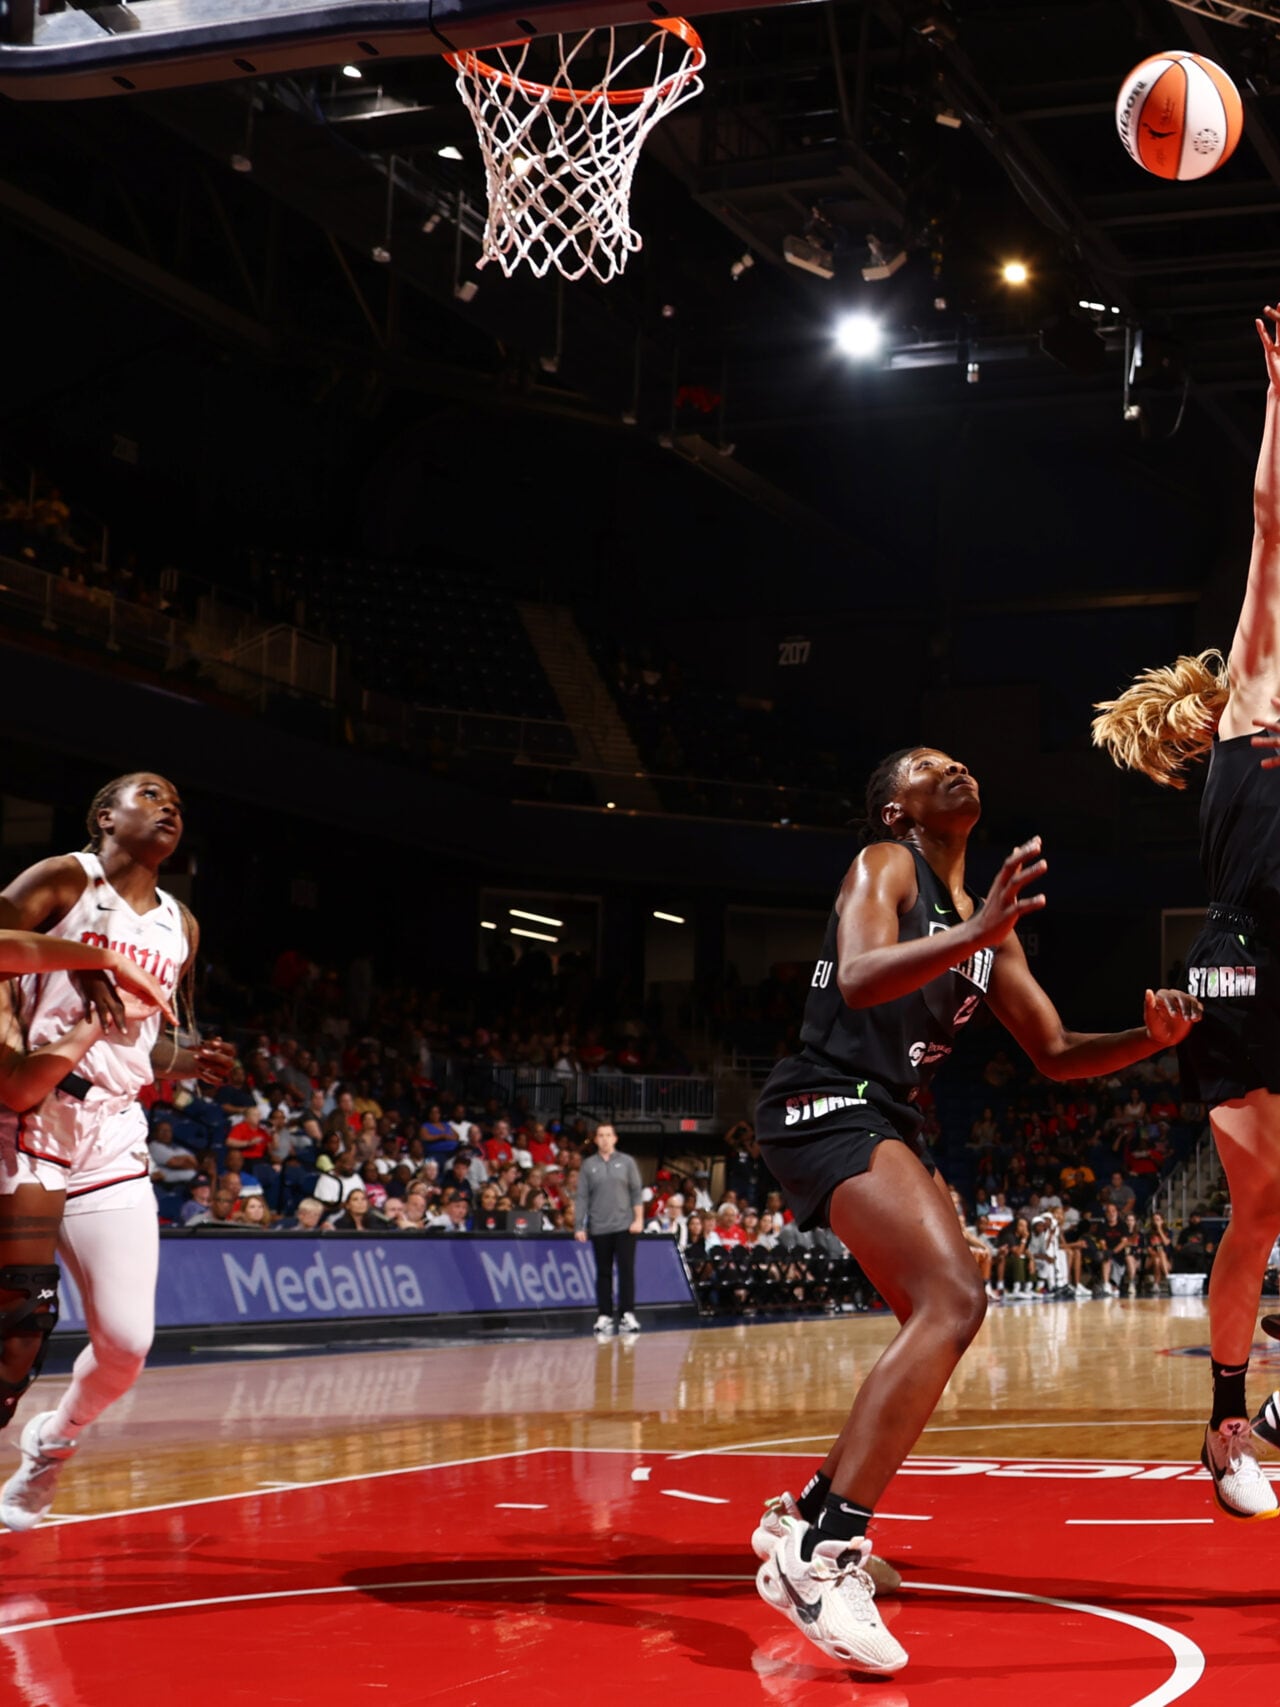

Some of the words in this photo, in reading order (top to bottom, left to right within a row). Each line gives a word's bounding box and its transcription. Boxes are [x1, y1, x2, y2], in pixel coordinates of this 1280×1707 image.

[779, 642, 811, 665] 207
[1188, 966, 1256, 998] STORM
[221, 1248, 425, 1314] Medallia
[481, 1249, 598, 1303] Medall
